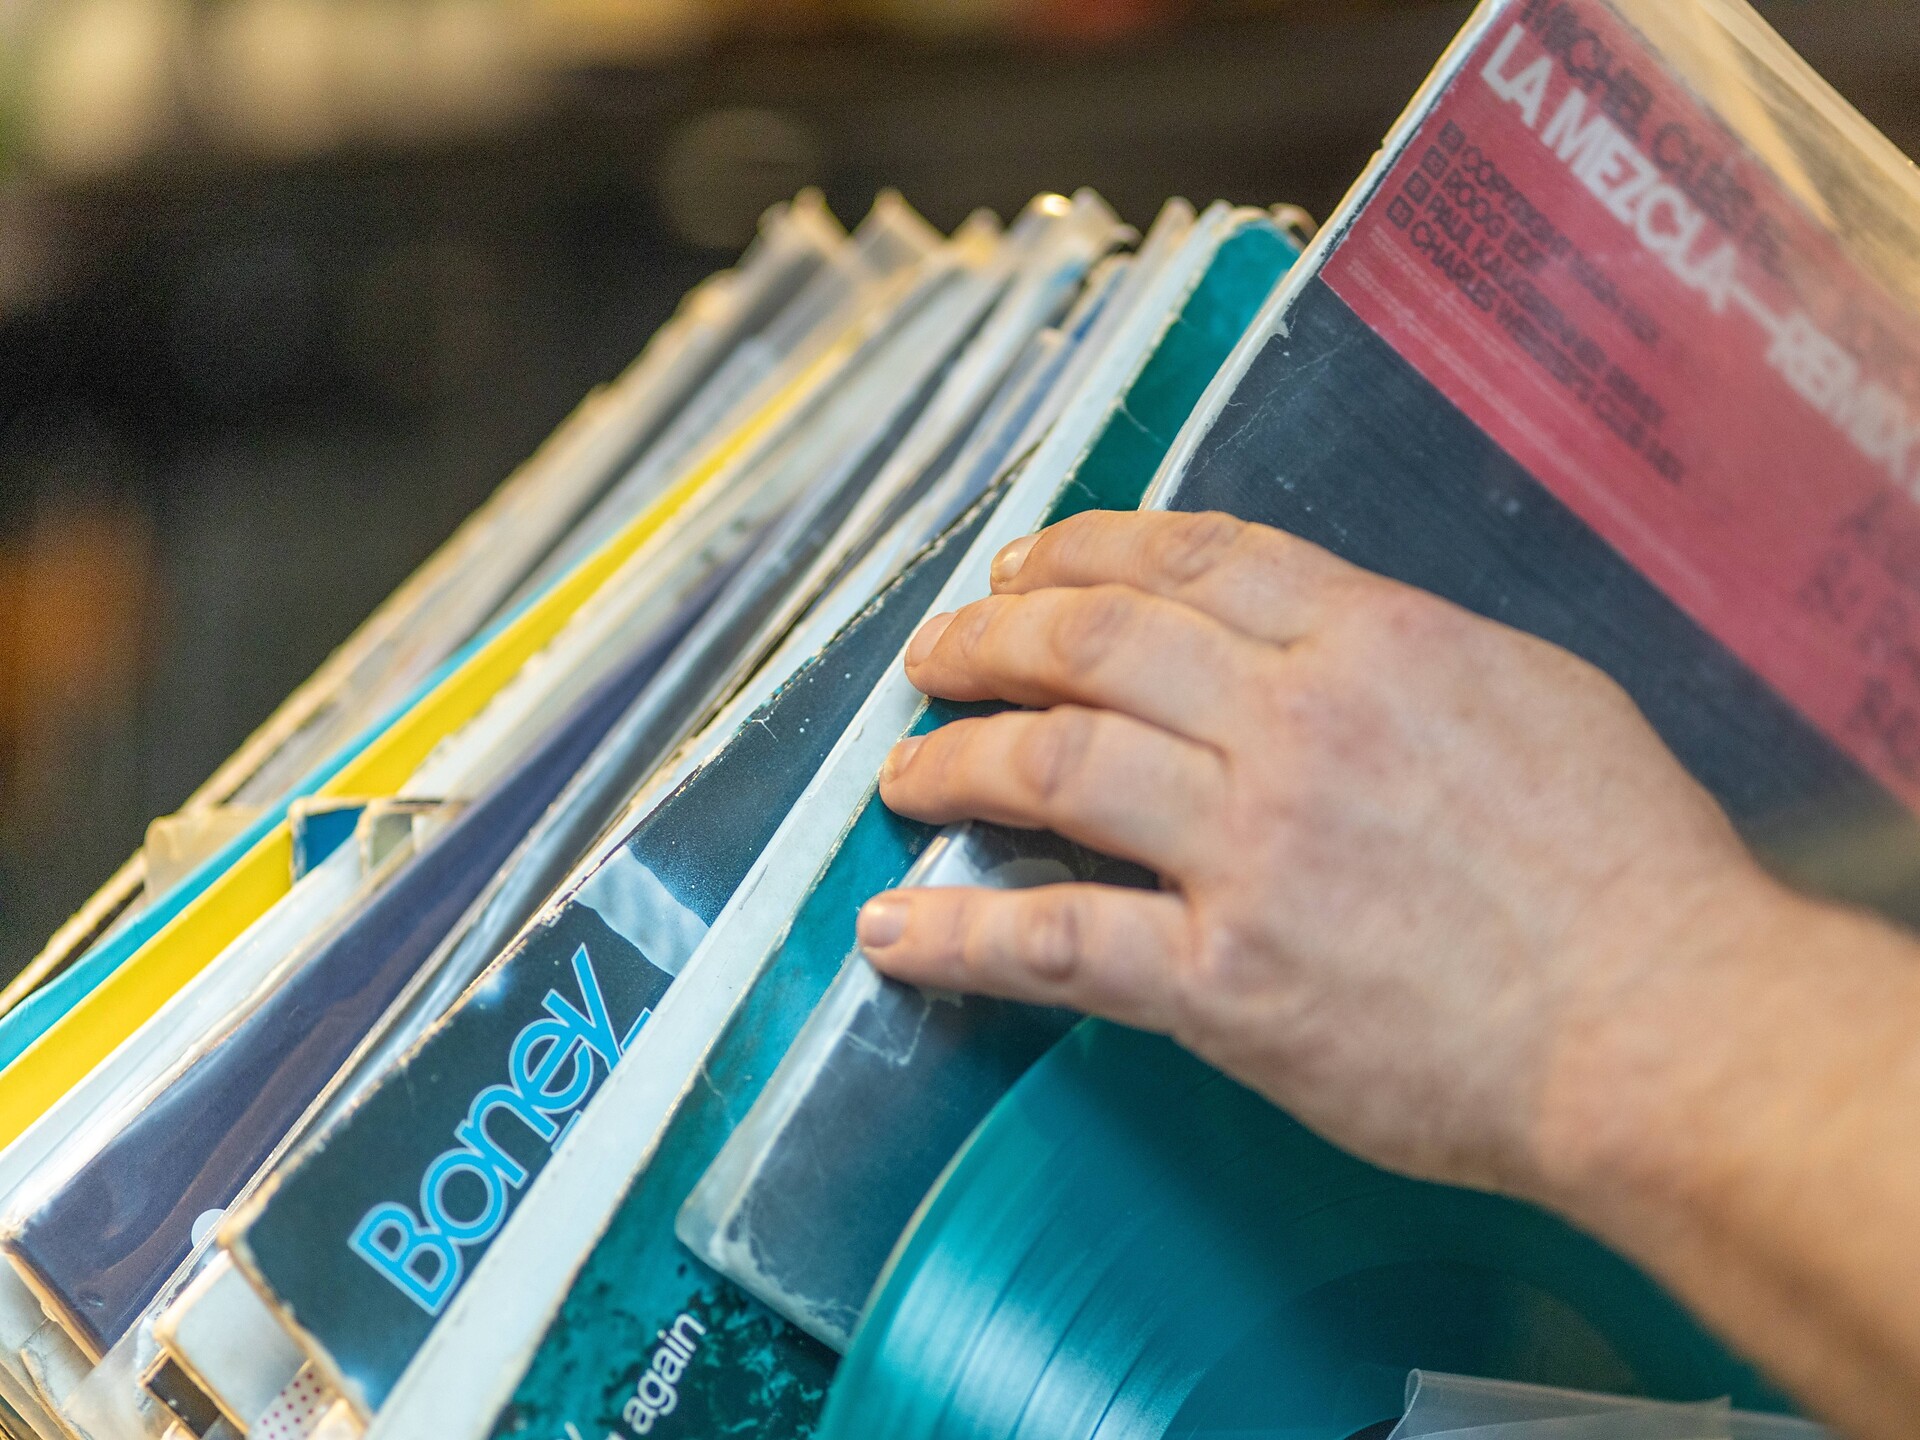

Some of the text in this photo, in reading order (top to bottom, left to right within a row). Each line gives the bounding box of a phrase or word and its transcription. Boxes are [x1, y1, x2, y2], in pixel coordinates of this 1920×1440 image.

[1479, 22, 1553, 129] LA
[1424, 192, 1481, 252] PAUL
[1440, 168, 1512, 242] ROOG
[1406, 216, 1505, 315] CHARLES
[347, 942, 624, 1316] Boney
[622, 1313, 706, 1435] again
